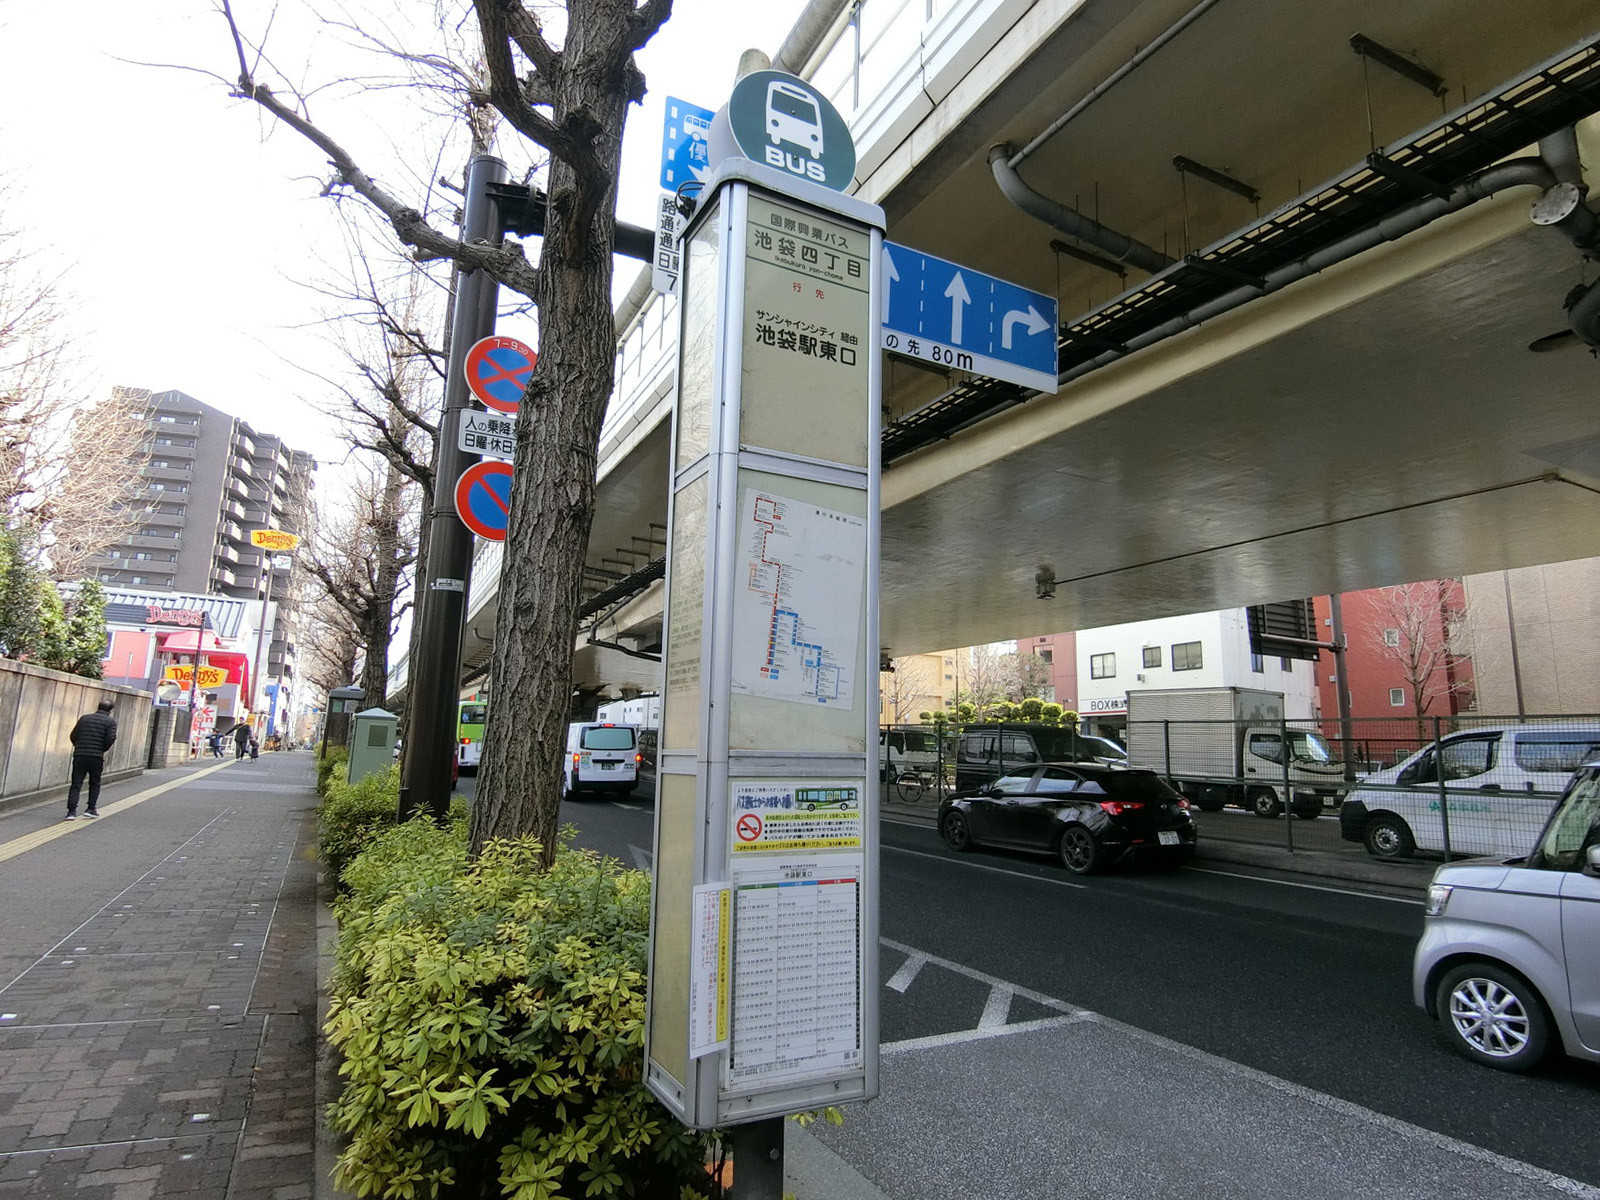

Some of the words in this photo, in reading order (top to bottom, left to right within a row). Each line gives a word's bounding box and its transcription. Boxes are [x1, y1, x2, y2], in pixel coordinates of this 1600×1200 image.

[688, 141, 708, 164] 優
[765, 144, 826, 182] BUS
[770, 212, 849, 249] 国際興業バス
[754, 229, 861, 278] 池袋四丁目
[755, 308, 837, 339] サンシャインシティ
[840, 331, 858, 346] 経由
[755, 322, 857, 367] 池袋駅東口
[932, 346, 973, 371] 80m
[464, 432, 517, 455] 日曜・休日
[256, 531, 295, 548] Denny's
[145, 604, 205, 627] Denny's
